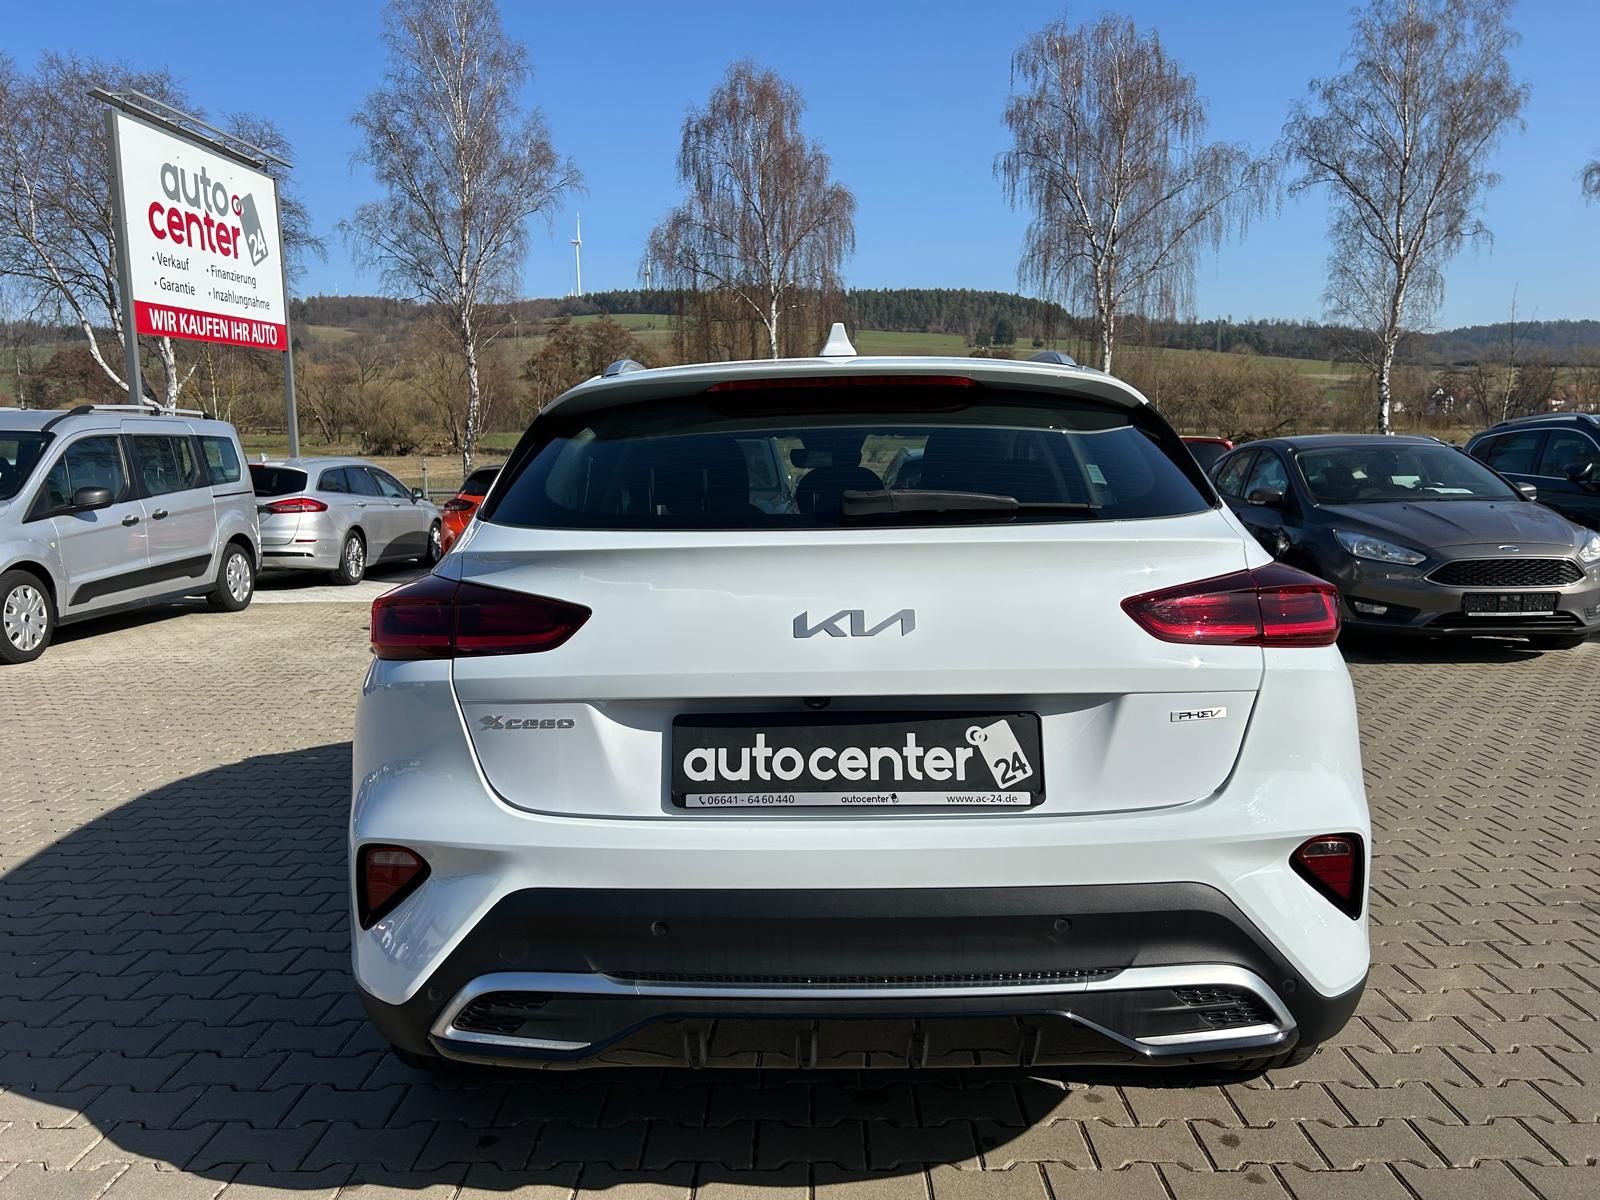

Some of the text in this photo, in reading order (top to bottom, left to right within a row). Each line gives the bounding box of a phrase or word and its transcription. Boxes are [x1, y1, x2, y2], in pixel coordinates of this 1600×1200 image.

[160, 162, 229, 217] auto
[148, 201, 241, 260] center
[248, 228, 267, 262] 24
[156, 251, 190, 271] Verkauf
[159, 276, 196, 296] Garantie
[210, 264, 257, 289] Finanzierung
[212, 287, 271, 311] Inzahlungnahme
[149, 308, 278, 346] WIR KAUFEN IHR AUTO
[793, 608, 916, 638] KIA
[1178, 709, 1222, 720] PHEV
[993, 751, 1028, 785] 24
[707, 796, 738, 805] 06641
[841, 793, 889, 804] autocenter
[946, 793, 1018, 804] www.ac-24.de
